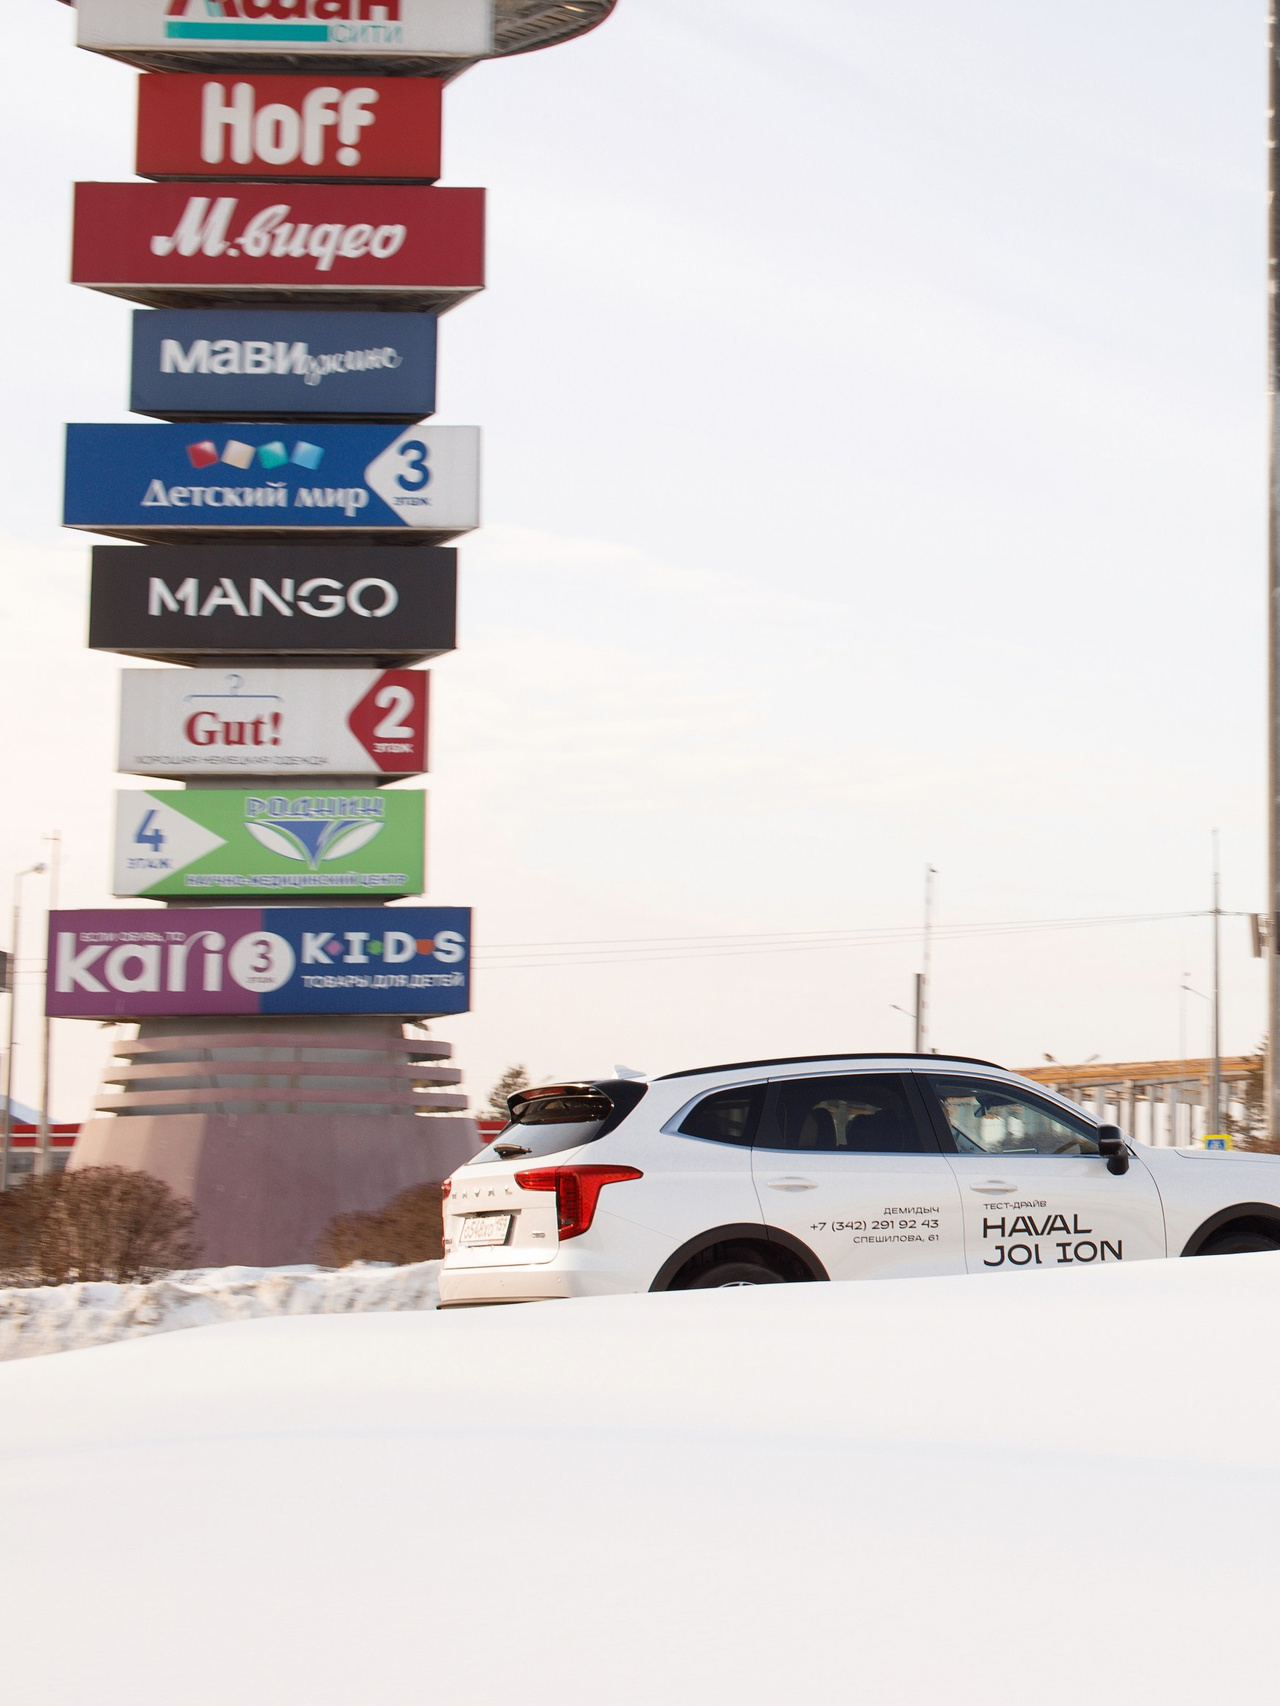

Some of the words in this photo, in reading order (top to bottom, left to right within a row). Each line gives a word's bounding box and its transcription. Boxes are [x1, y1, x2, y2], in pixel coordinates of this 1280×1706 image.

[151, 197, 407, 271] М.видео
[394, 440, 431, 492] 3
[141, 479, 288, 508] Детский
[294, 487, 369, 517] мир
[148, 577, 399, 618] MANGO
[183, 711, 284, 747] Gut!
[371, 685, 416, 739] 2
[244, 796, 386, 819] РОДНИК
[134, 809, 165, 853] 4
[54, 931, 227, 993] kari
[251, 940, 272, 973] 3
[883, 1207, 939, 1215] ДЕМИДЫЧ
[984, 1200, 1047, 1210] ТЕСТ-ДРАЙВ
[810, 1222, 827, 1231] +7
[831, 1220, 867, 1232] (342)
[871, 1220, 894, 1230] 291
[898, 1219, 917, 1229] 92
[921, 1219, 939, 1228] 43
[853, 1235, 925, 1243] СПЕШИЛОВА,
[928, 1234, 939, 1242] 61
[983, 1214, 1093, 1238] HAVAL
